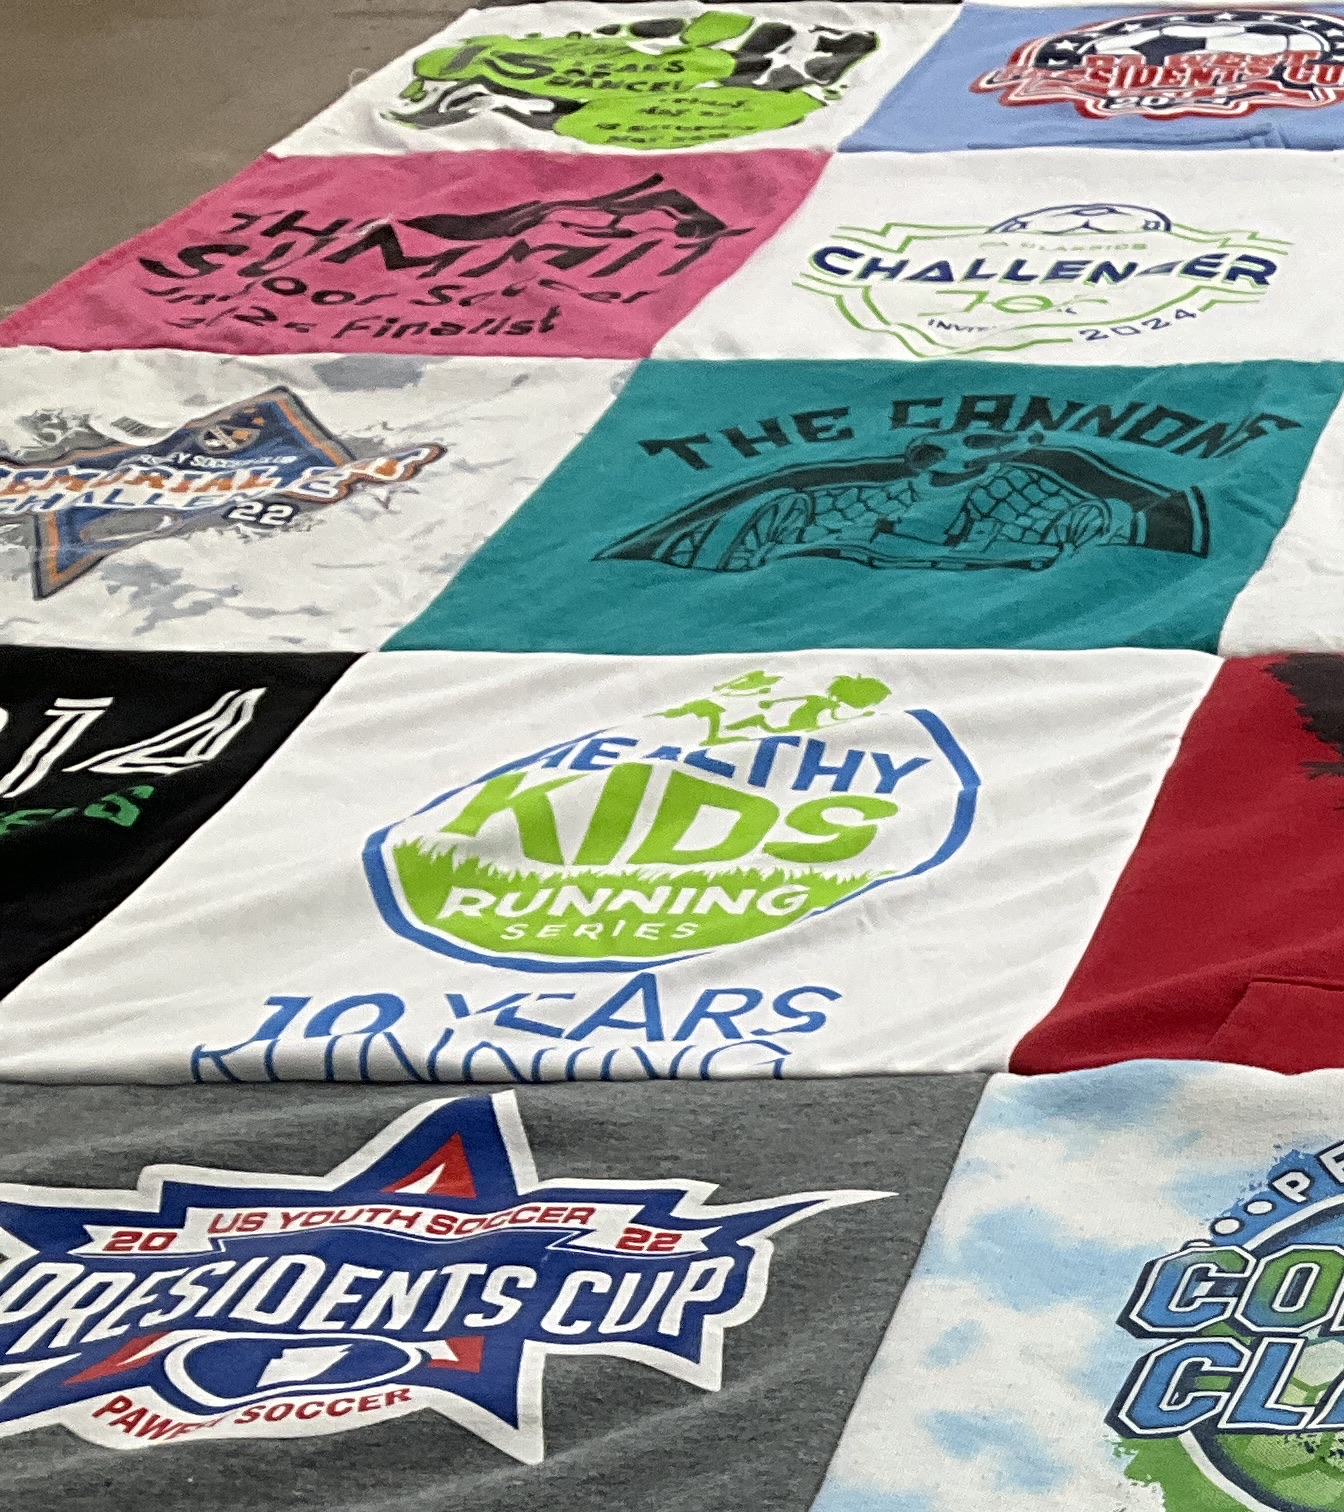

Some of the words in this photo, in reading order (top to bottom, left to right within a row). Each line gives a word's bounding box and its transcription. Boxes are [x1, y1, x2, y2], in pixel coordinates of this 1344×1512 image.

[332, 304, 561, 340] Finalist
[1078, 307, 1198, 341] 2024
[638, 406, 854, 471] THE
[227, 501, 297, 527] 22
[0, 687, 269, 799] 14
[441, 769, 897, 868] KIDS
[434, 882, 812, 923] RUNNING
[500, 921, 700, 943] SERIES
[249, 993, 406, 1043] 10
[443, 971, 846, 1043] YEARS
[102, 1229, 179, 1254] 20
[207, 1209, 271, 1237] US
[278, 1206, 422, 1232] YOUTH
[425, 1205, 599, 1239] SOCCER
[613, 1227, 687, 1254] 22
[0, 1252, 546, 1356] PRESIDENTS
[541, 1254, 736, 1336] CUP
[233, 1387, 413, 1426] SOCCER
